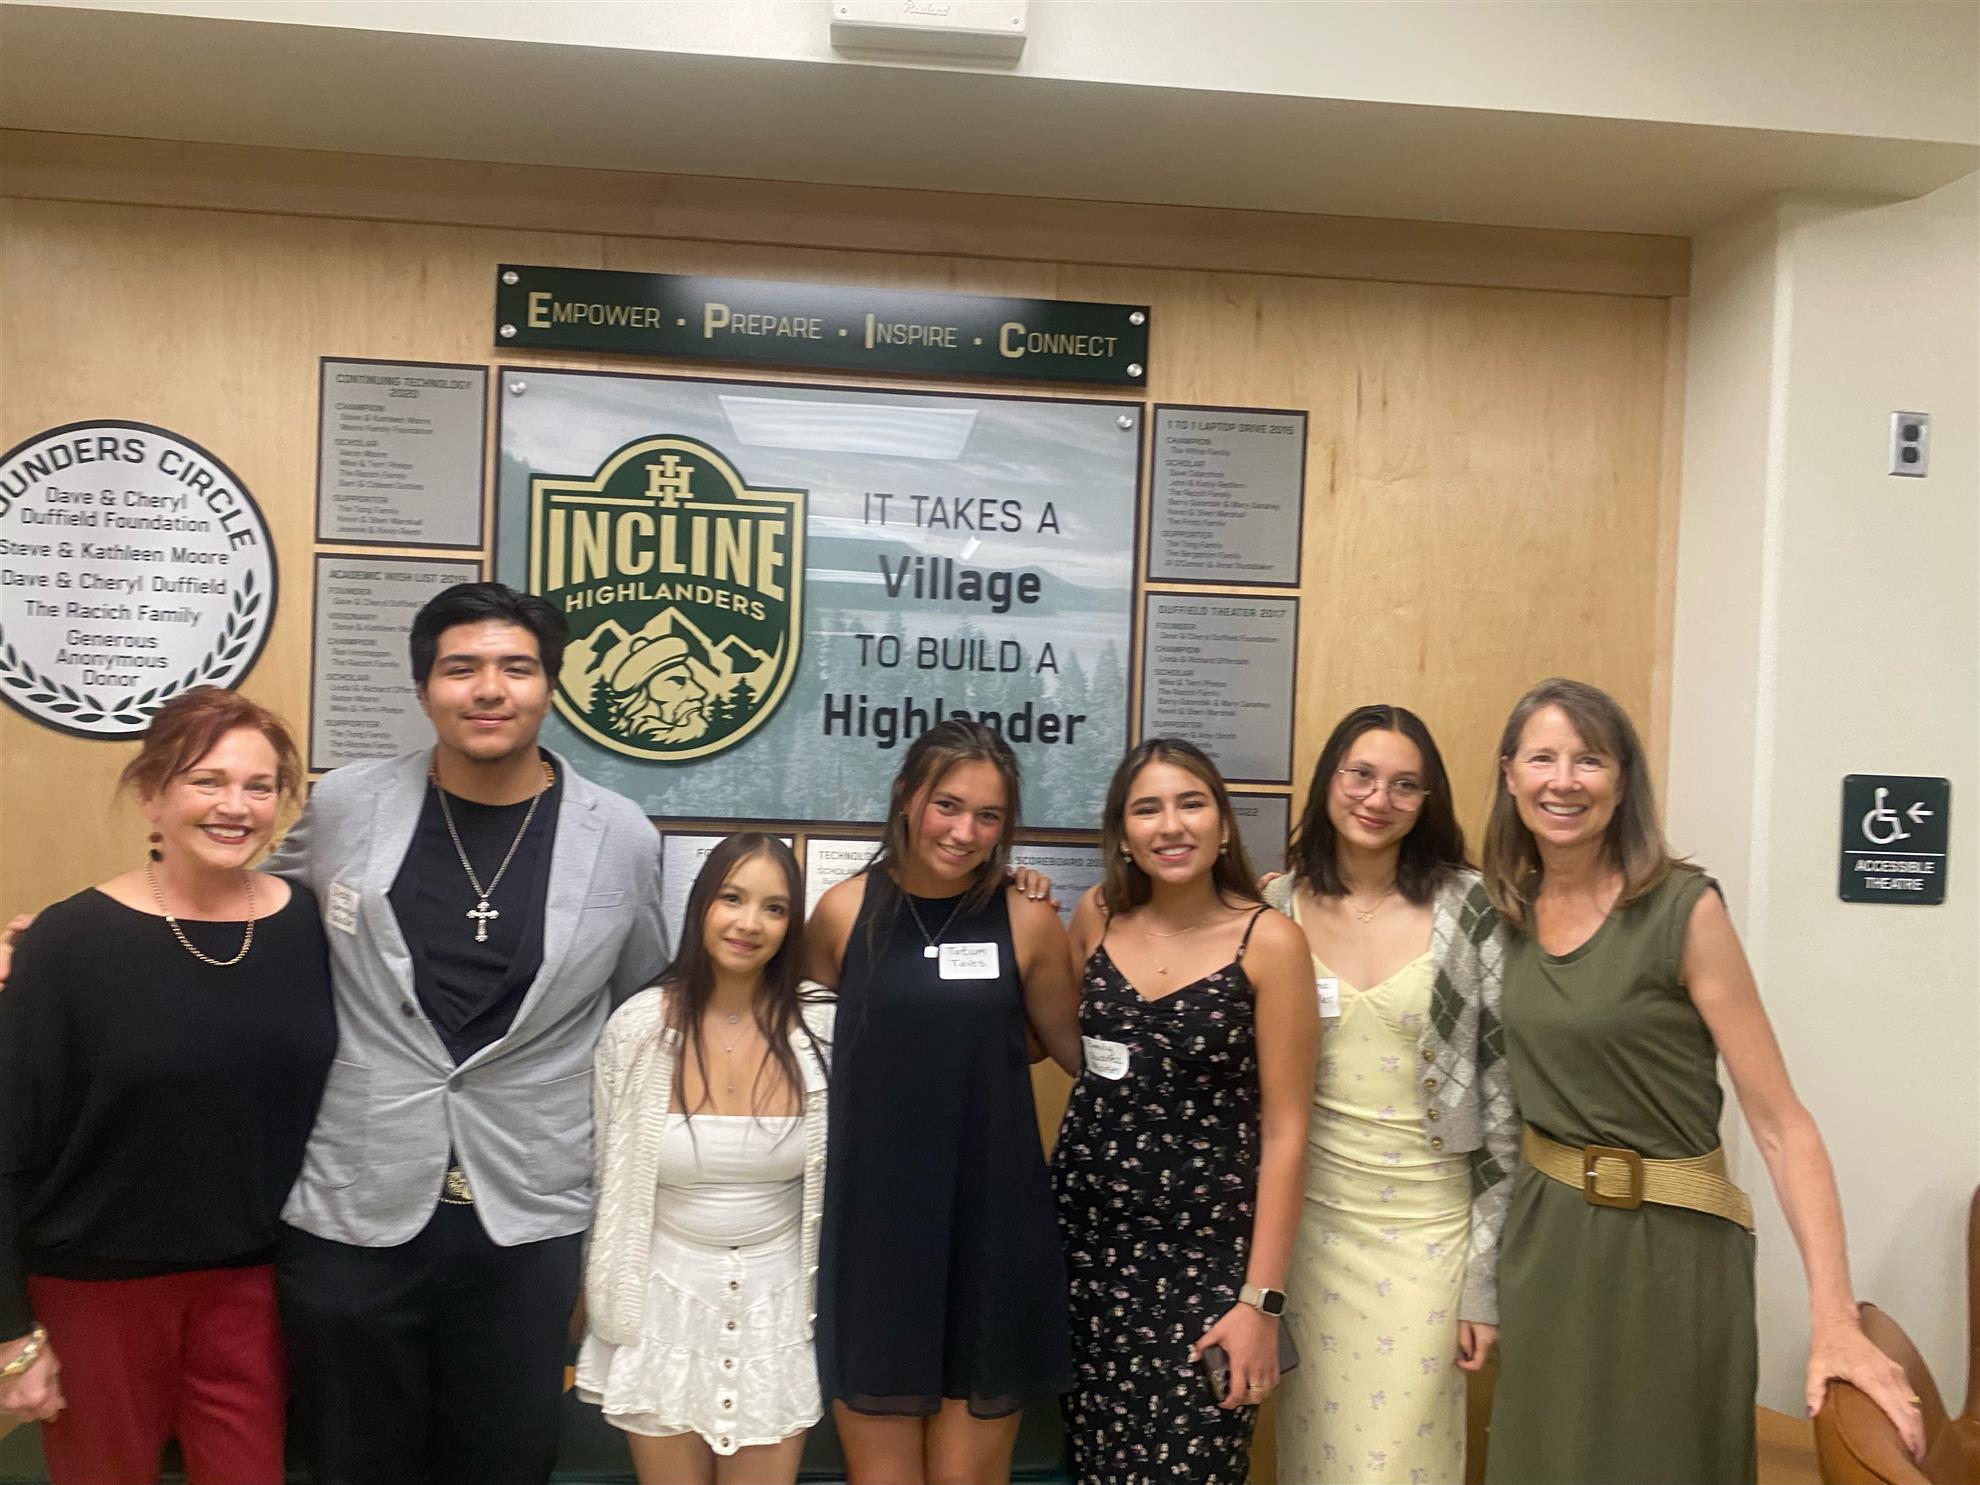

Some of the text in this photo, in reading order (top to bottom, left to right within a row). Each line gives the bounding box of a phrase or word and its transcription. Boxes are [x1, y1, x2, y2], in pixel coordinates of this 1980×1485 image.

[528, 291, 1118, 358] EMPOWER PREPARE INSPIRE CONNECT
[336, 374, 472, 390] CONTINUING TECHNOLOGY
[389, 388, 419, 398] 2020
[1175, 420, 1189, 430] TO
[1198, 422, 1236, 432] LAPTOP
[0, 436, 257, 552] UNDERS CIRCLE
[46, 486, 187, 512] Dave & Cheryl
[22, 508, 210, 532] Duffield Foundation
[864, 492, 1060, 534] IT TAKES A
[0, 538, 228, 564] Steve & Kathleen Moore
[547, 508, 785, 602] INCLINE
[2, 570, 228, 594] Dave & Cheryl Duffield
[330, 570, 382, 580] ACADEMIC
[385, 572, 412, 582] WISH
[416, 574, 437, 582] LIST
[879, 554, 1042, 613] Village
[566, 582, 766, 620] HIGHLANDERS
[1158, 605, 1208, 616] DUFFIELD
[1210, 607, 1256, 617] THEATER
[24, 600, 202, 627] The Racich Family
[66, 630, 158, 648] Generous
[55, 649, 168, 670] Anonymous
[855, 634, 1058, 674] TO BUILD A
[82, 670, 140, 686] Donor
[824, 693, 1086, 750] Highlnder
[820, 850, 874, 860] TECHNOLO
[1016, 856, 1082, 866] SCOREBOARD
[1854, 860, 1935, 874] ACCESSIBLE
[1864, 877, 1924, 890] THEATRE
